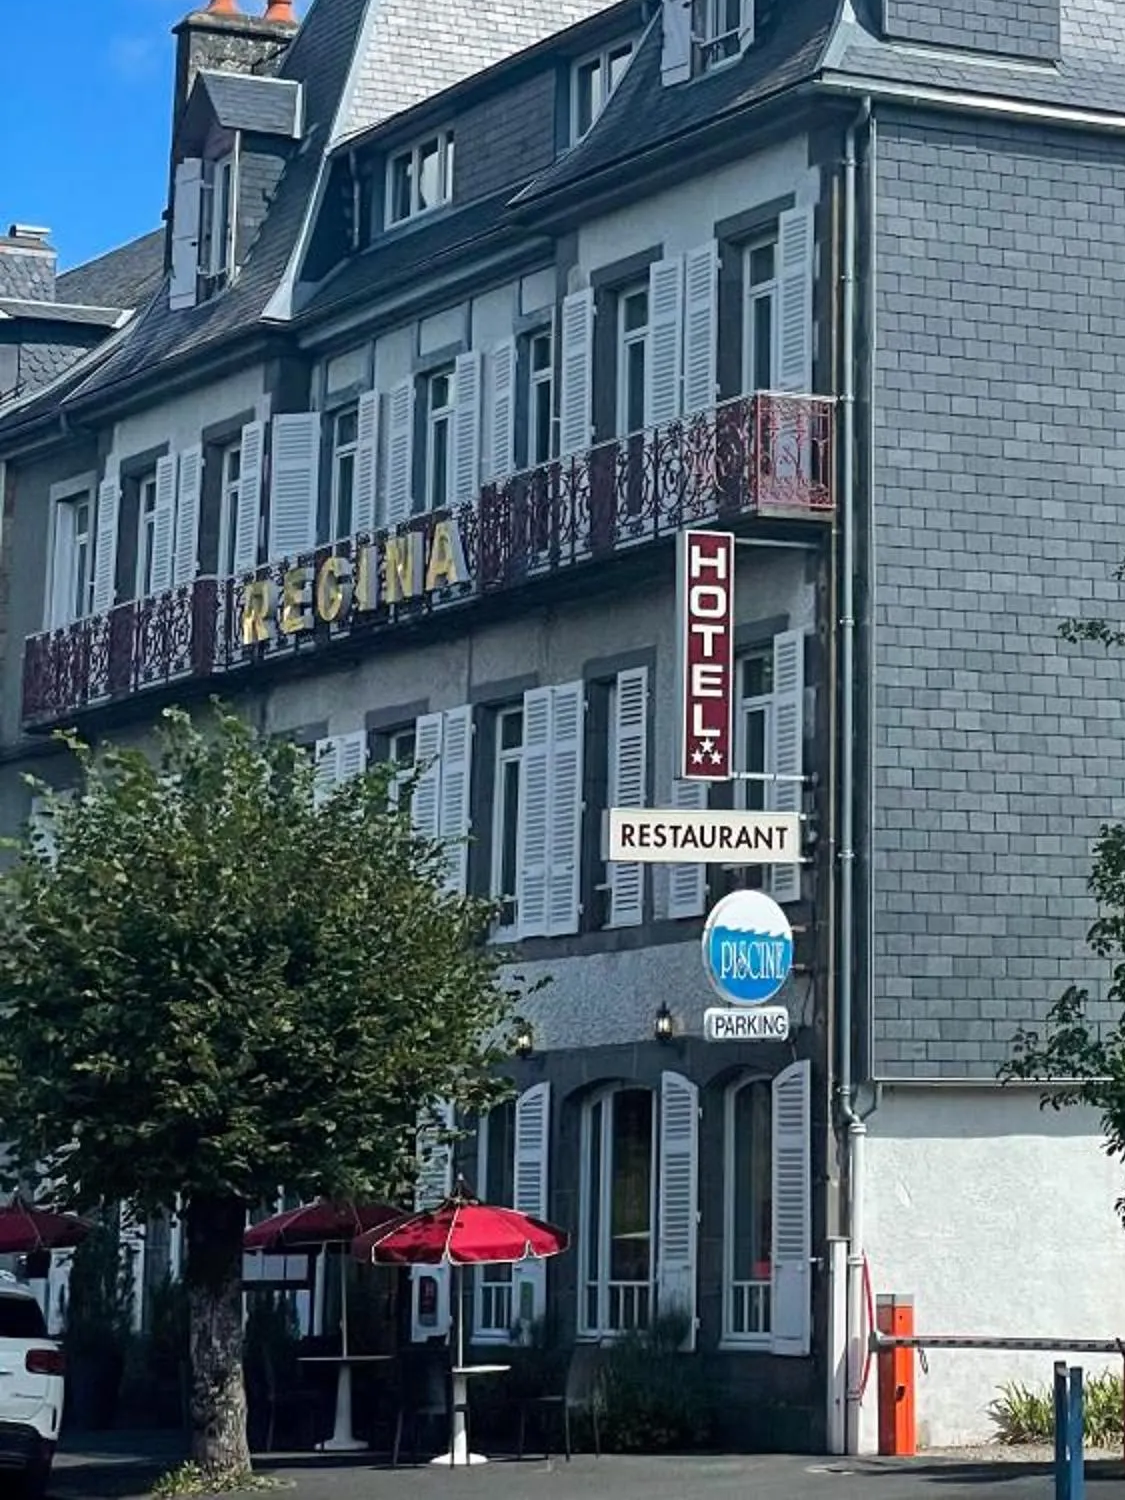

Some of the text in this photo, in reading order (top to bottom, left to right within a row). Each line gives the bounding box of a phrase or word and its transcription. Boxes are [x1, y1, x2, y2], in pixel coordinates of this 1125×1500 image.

[241, 519, 470, 644] REGINA
[690, 546, 727, 737] HOTEL
[621, 824, 788, 850] RESTAURANT
[721, 940, 785, 979] PISCINE
[715, 1015, 786, 1035] PARKING
